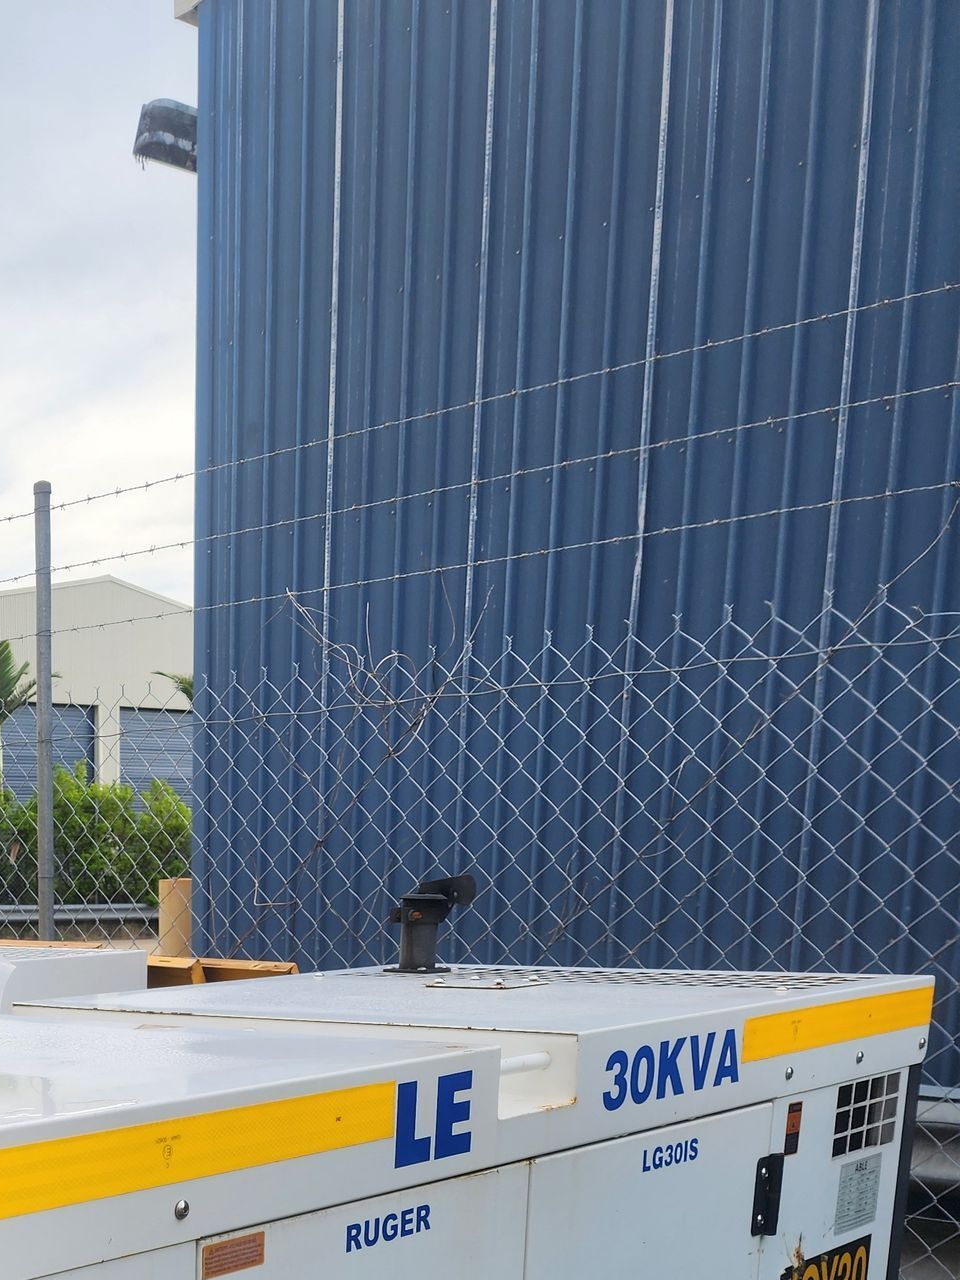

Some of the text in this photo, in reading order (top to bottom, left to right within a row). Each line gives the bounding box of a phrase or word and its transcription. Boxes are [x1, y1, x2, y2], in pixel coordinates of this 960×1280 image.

[603, 1029, 739, 1111] 30KVA
[395, 1070, 472, 1169] LE
[346, 1204, 431, 1253] RUGER
